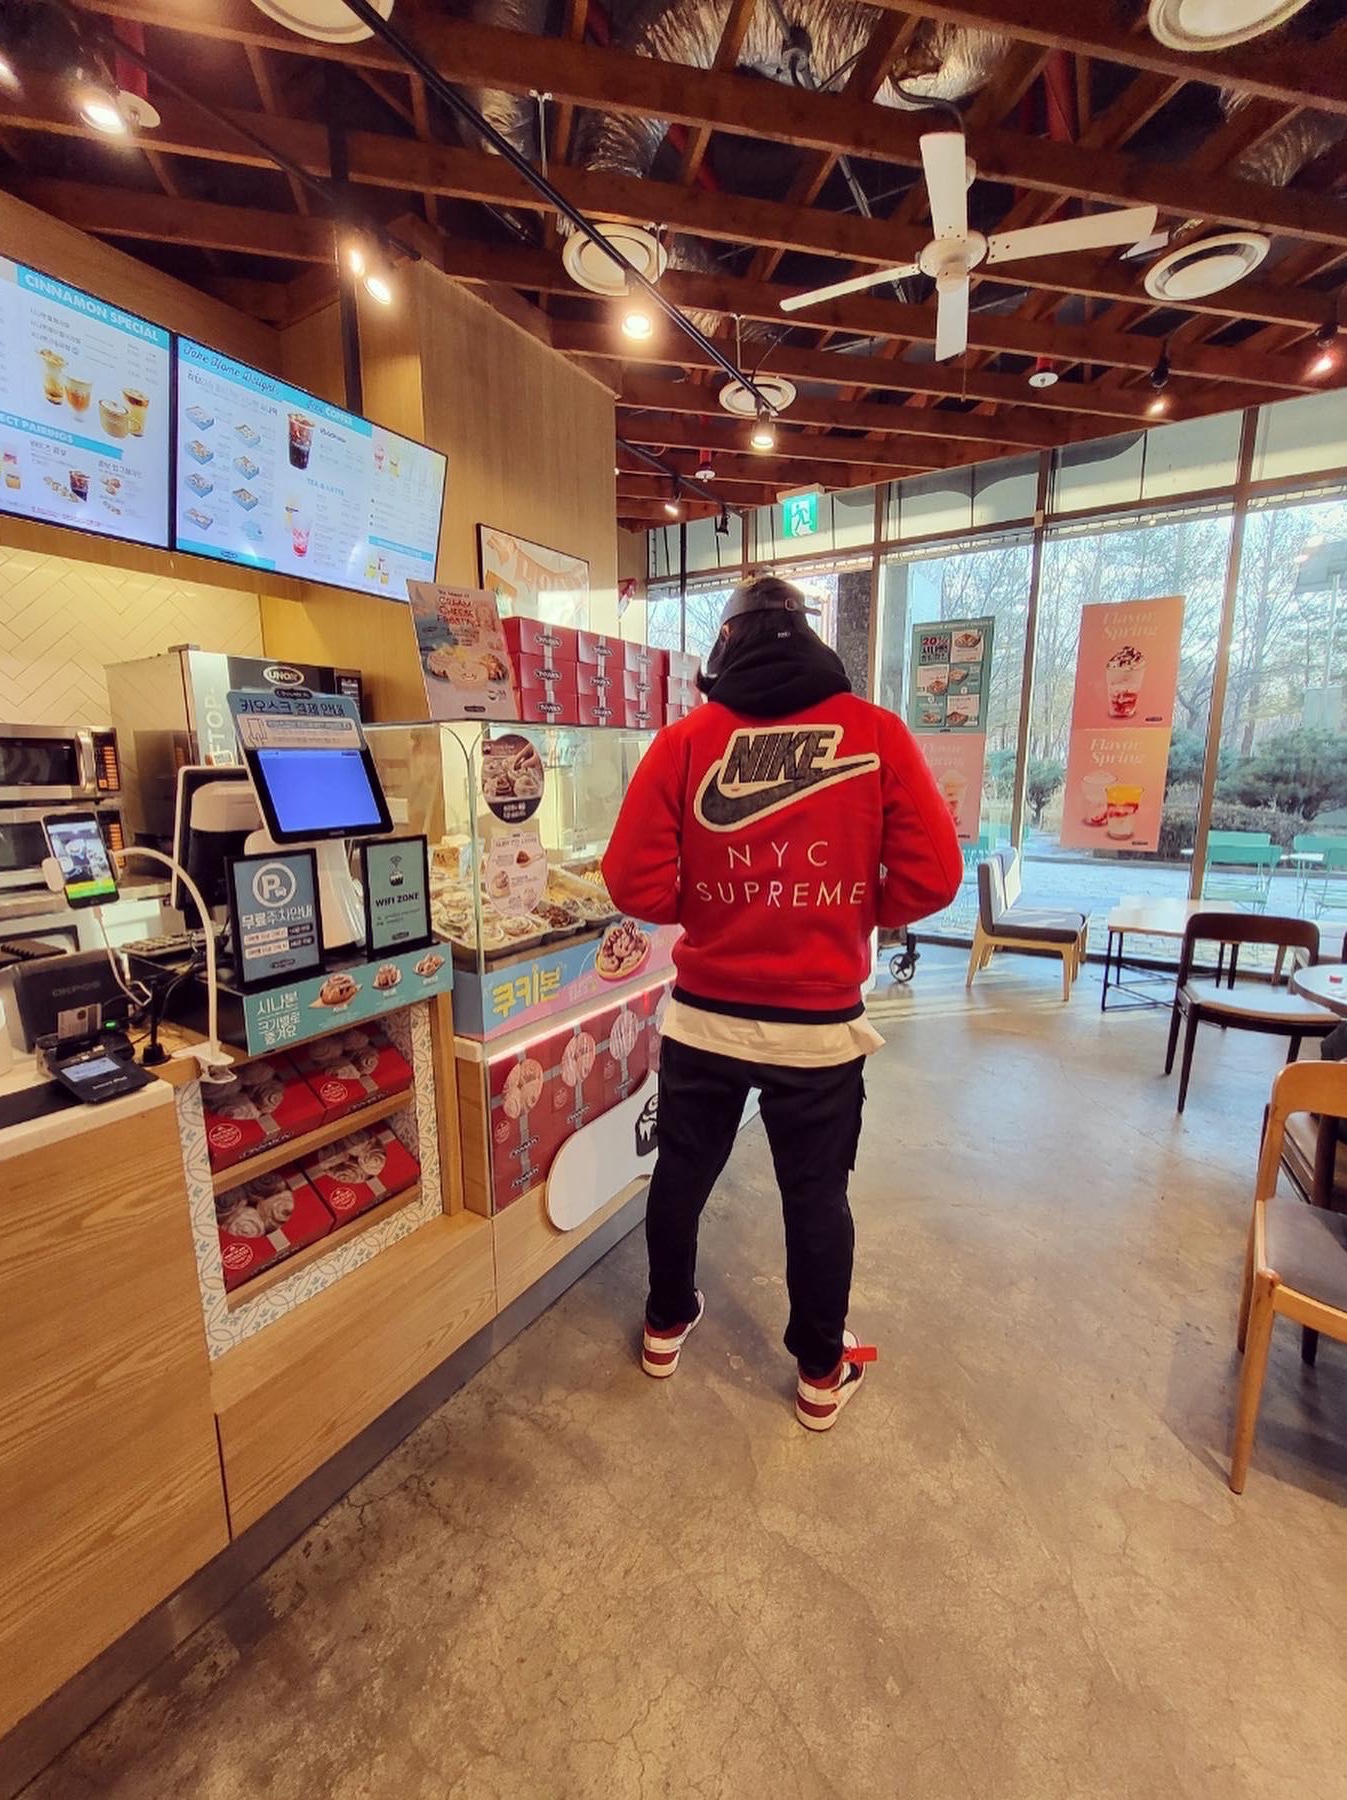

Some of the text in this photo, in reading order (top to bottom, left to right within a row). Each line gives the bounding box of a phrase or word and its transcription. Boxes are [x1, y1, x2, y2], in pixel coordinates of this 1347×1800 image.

[25, 273, 108, 320] CINNAMON
[110, 312, 159, 342] SPECIAL
[1103, 625, 1159, 641] Spring
[721, 729, 836, 785] NIKE
[1090, 751, 1144, 768] Spring
[375, 892, 418, 908] WIFI ZONE
[696, 880, 867, 908] SUPREME
[491, 962, 561, 1019] 쿠키본
